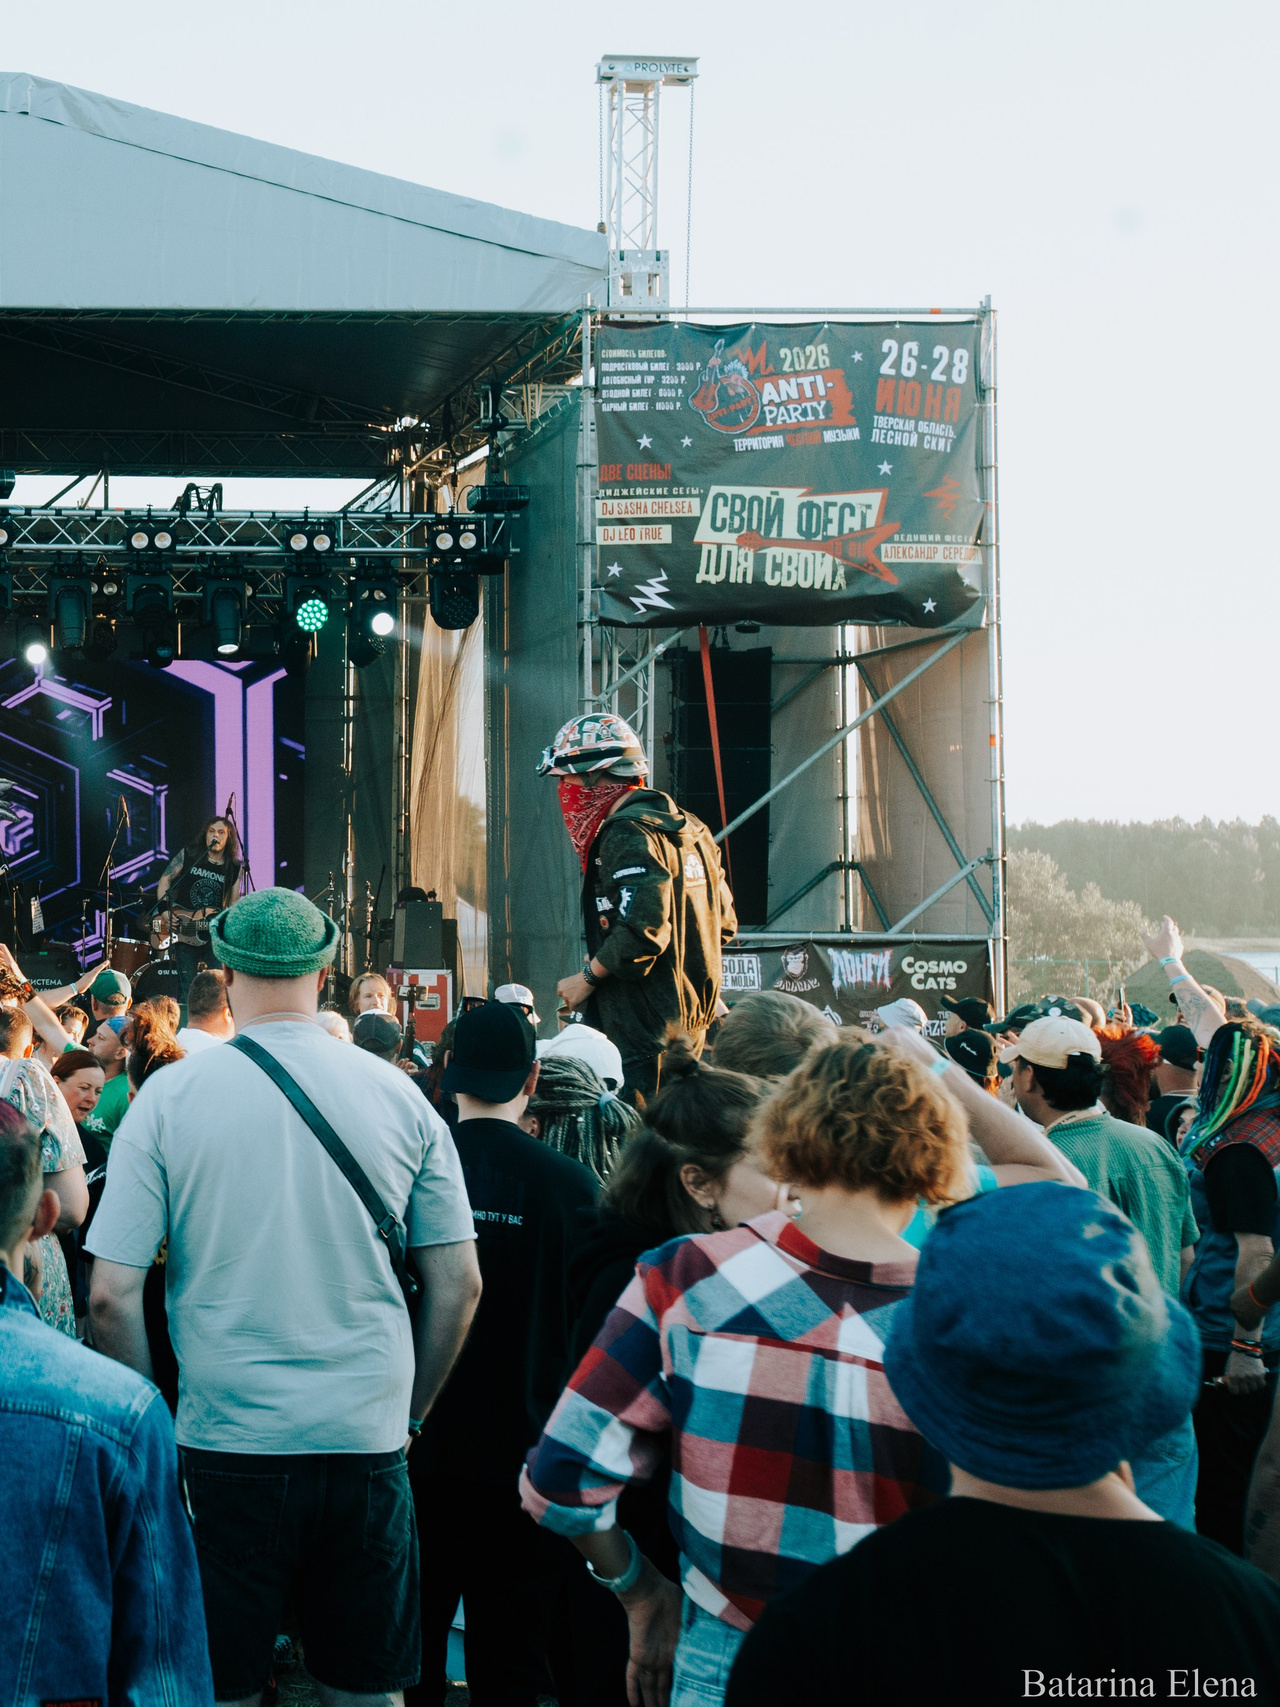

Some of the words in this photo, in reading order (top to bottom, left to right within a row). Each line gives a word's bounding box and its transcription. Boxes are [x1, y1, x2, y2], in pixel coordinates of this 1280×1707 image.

[634, 62, 683, 73] PROLYTE
[779, 343, 830, 372] 2026
[879, 338, 969, 384] 26-28
[601, 361, 649, 372] ПОДРОСТКОВЫЙ
[650, 361, 670, 372] БИЛЕТ
[676, 362, 694, 372] 3000
[631, 388, 652, 397] БИЛЕТ
[762, 374, 834, 405] ANTI-
[628, 402, 649, 411] БИЛЕТ
[876, 377, 962, 423] ИЮНЯ
[763, 400, 827, 426] PARTY
[873, 415, 915, 431] ТВЕРСКАЯ
[733, 435, 784, 452] ТЕРРИТОРИЯ
[823, 427, 860, 443] МУЗЫКИ
[870, 428, 918, 448] ЛЕСНОЙ
[923, 435, 953, 453] СКИТ
[600, 463, 624, 482] ДВЕ
[626, 463, 672, 481] СЦЕНЫ!
[599, 486, 669, 497] ДИДЖЕЙСКИЕ
[601, 502, 614, 516] DJ
[617, 501, 648, 515] SASHA
[651, 500, 693, 514] CHELSEA
[710, 490, 784, 539] СВОЙ
[796, 500, 872, 542] ФЕСТ
[603, 528, 616, 542] DJ
[618, 527, 636, 541] LEO
[639, 526, 663, 541] TRUE
[894, 533, 941, 542] ВЕДУЩИЙ
[883, 545, 938, 560] АЛЕКСАНДР
[696, 543, 754, 585] ДЛЯ
[190, 866, 225, 883] RAMONE
[901, 956, 967, 976] COSMO
[28, 978, 63, 986] ИСТЕМА
[731, 975, 756, 987] МОДЫ
[911, 972, 957, 990] CATS
[508, 1214, 523, 1226] ВАС
